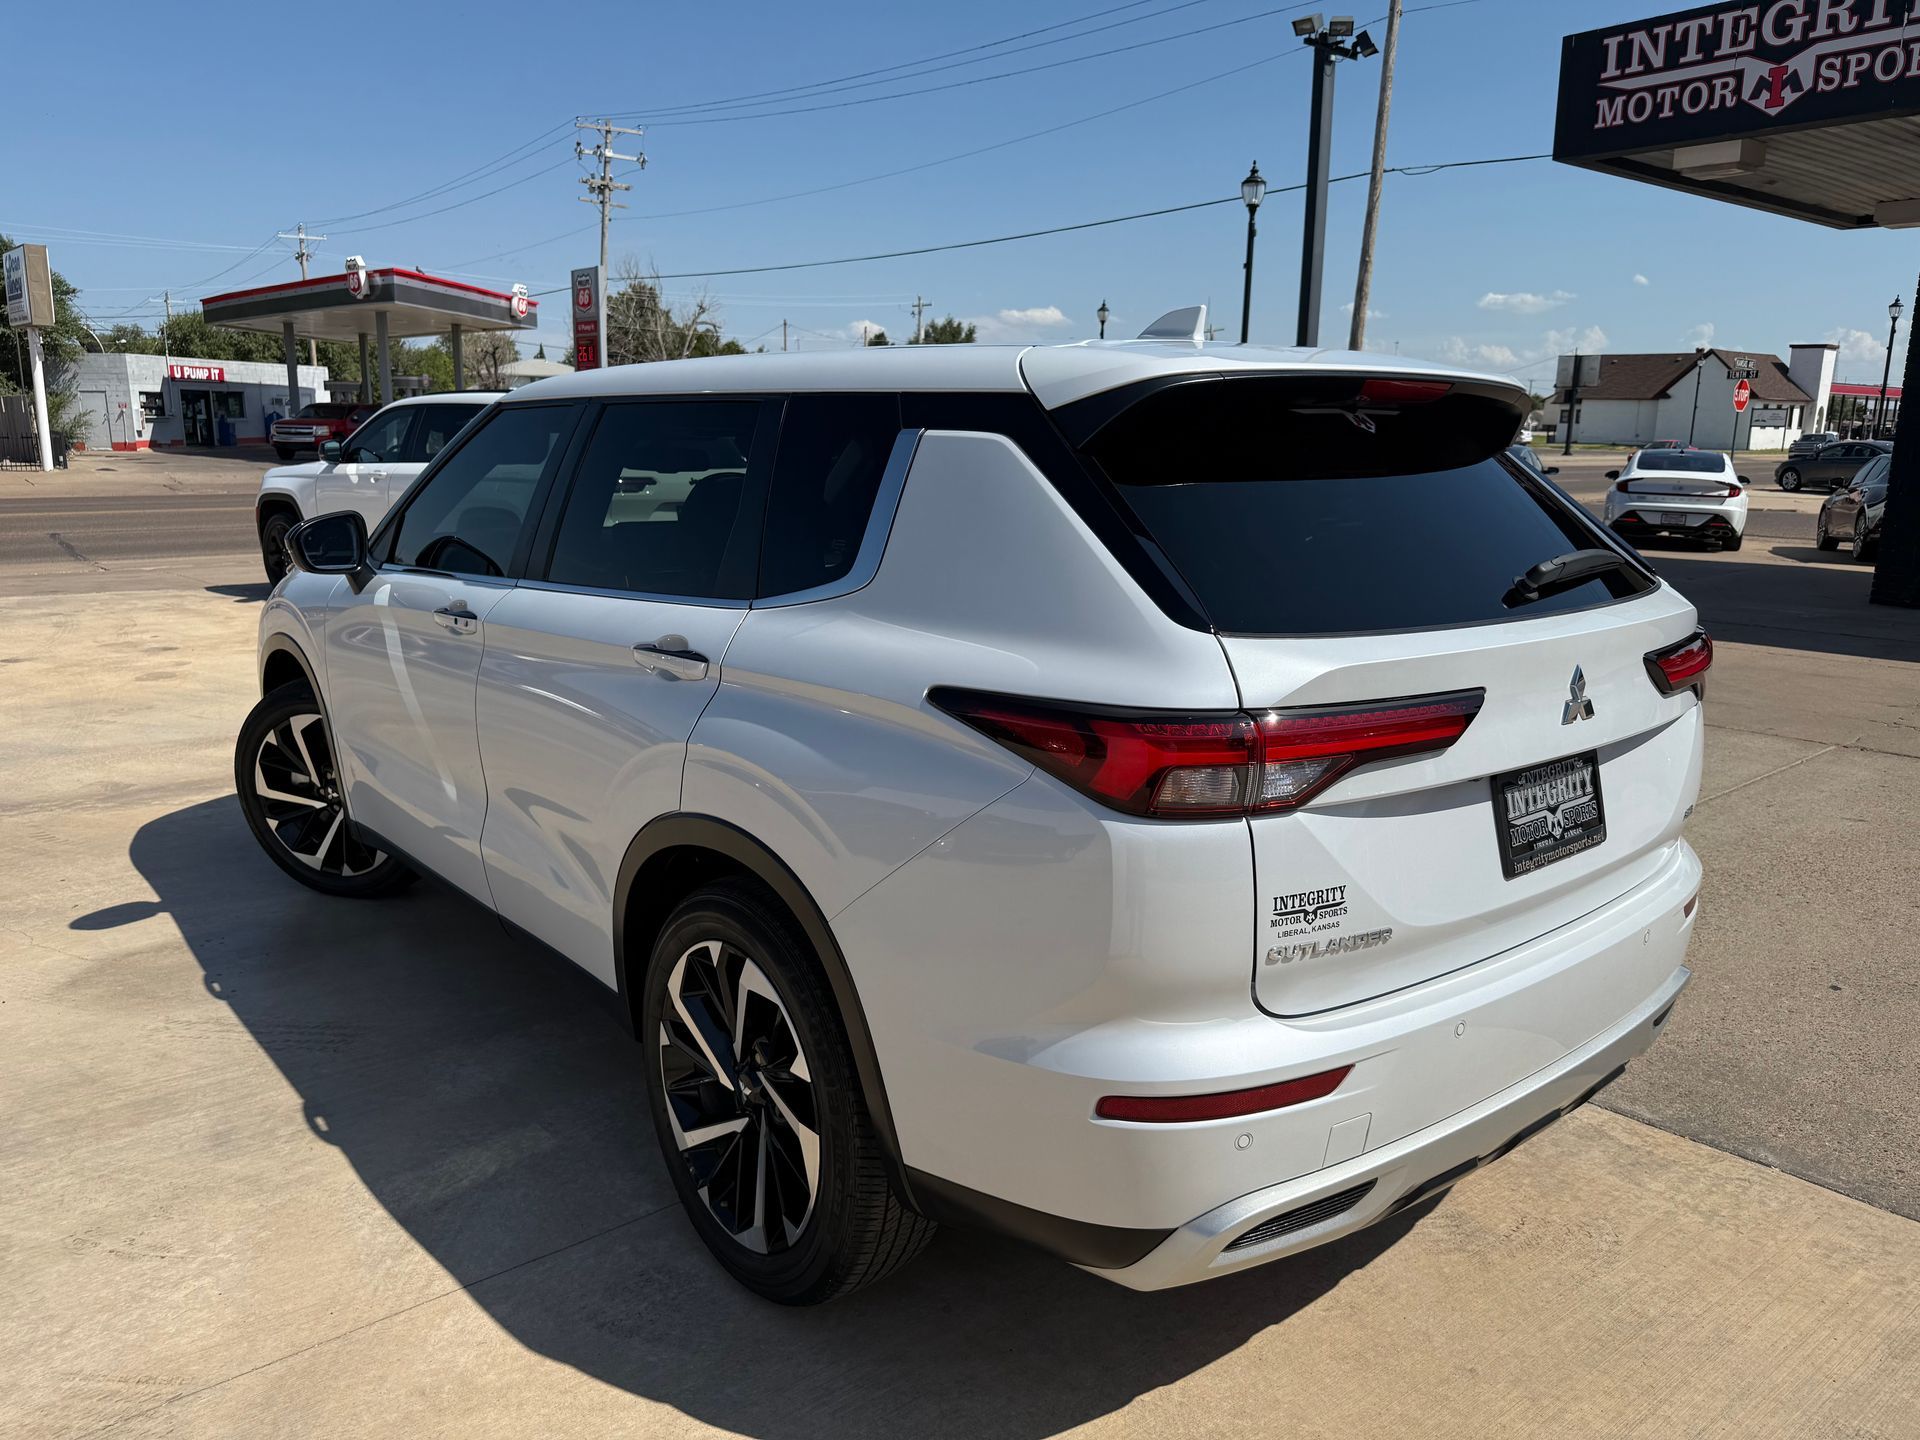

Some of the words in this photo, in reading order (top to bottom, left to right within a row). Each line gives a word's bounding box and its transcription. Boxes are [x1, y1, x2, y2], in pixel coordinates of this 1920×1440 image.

[1601, 0, 1920, 79] INTEGRI
[1594, 77, 1738, 129] MOTOR
[350, 273, 359, 289] 66
[518, 298, 528, 312] 66
[578, 290, 589, 306] 66
[174, 366, 181, 378] U
[184, 367, 209, 380] PUMP
[211, 368, 220, 381] IT
[1730, 370, 1747, 378] TENTH
[1750, 370, 1756, 378] ST
[1735, 389, 1748, 402] STOP
[1505, 766, 1594, 819] INTEGRITY
[1510, 818, 1548, 847] MOTOR
[1563, 801, 1598, 828] SPORTS
[1514, 831, 1605, 874] integritymotorsports.net
[1273, 885, 1346, 911] INTEGRITY
[1270, 915, 1301, 928] MOTOR
[1319, 907, 1348, 919] SPORTS
[1277, 927, 1310, 939] LIBERAL,
[1311, 920, 1340, 932] KANSAS
[1265, 927, 1393, 966] OUTLANDER
